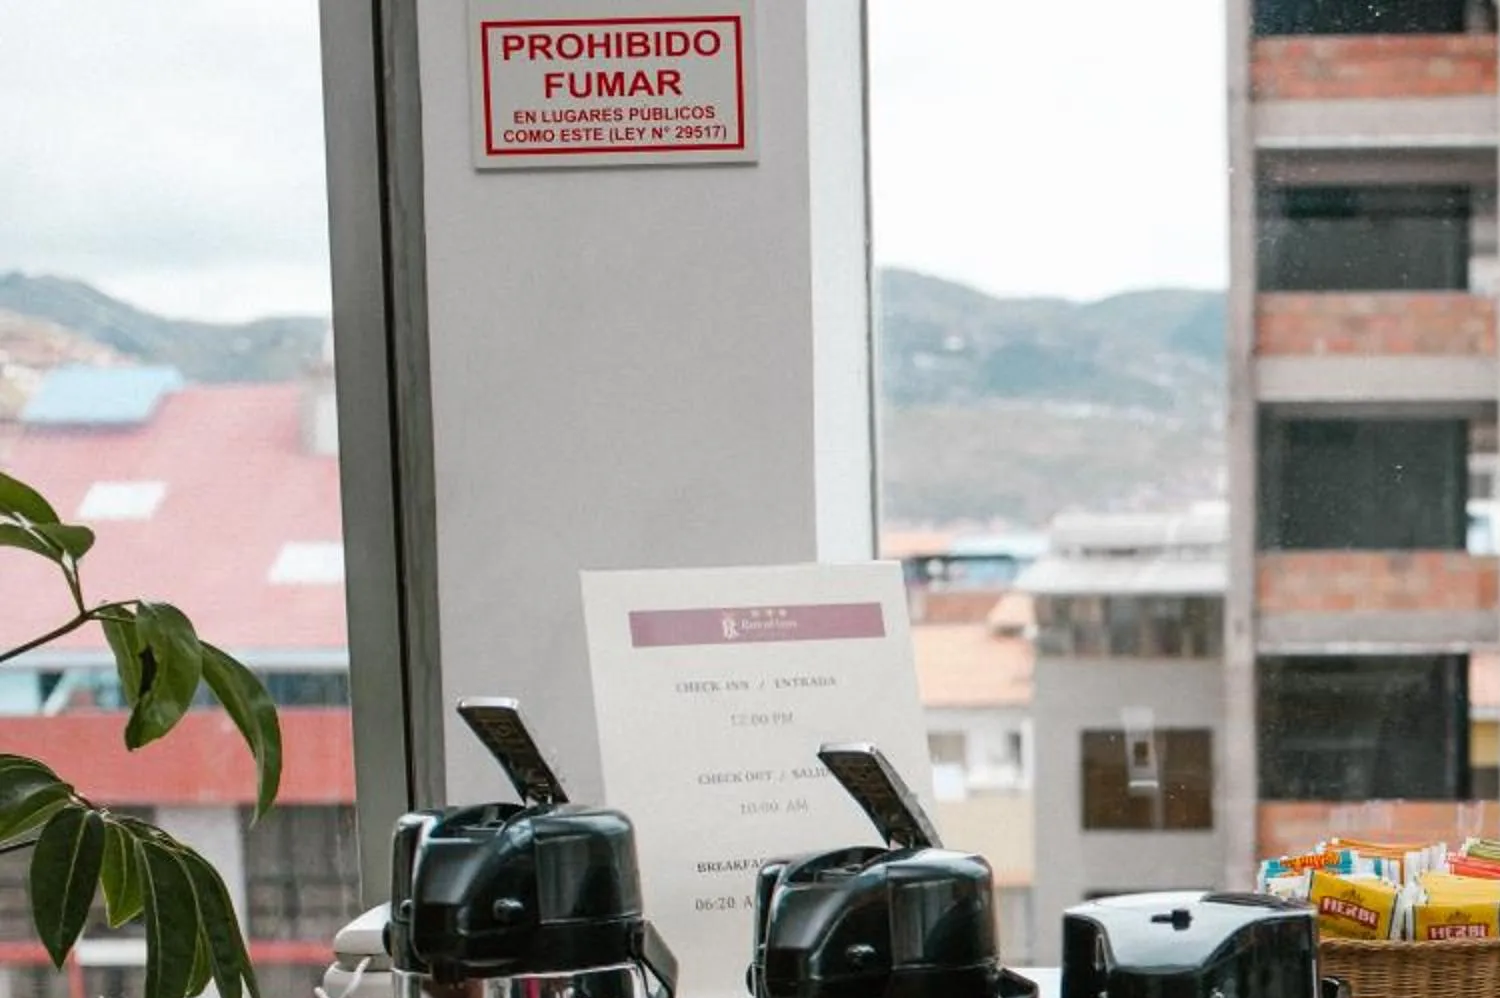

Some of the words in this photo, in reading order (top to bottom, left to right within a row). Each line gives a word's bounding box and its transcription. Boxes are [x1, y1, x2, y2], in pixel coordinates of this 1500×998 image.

[502, 30, 722, 60] PROHIBIDO
[544, 69, 682, 99] FUMAR
[513, 110, 536, 124] EN
[542, 108, 623, 123] LUGARES
[629, 105, 715, 122] PÚBLICOS
[503, 129, 555, 143] COMO
[560, 127, 604, 142] ESTE
[609, 126, 645, 143] (LEY
[675, 124, 728, 140] 29517)
[675, 680, 720, 693] CHECK
[774, 675, 837, 689] ENTRADA
[698, 772, 742, 785] CHECK
[791, 767, 830, 779] SALID
[786, 798, 808, 813] AM
[1322, 897, 1377, 925] HERBI
[1430, 925, 1486, 939] HERBI
